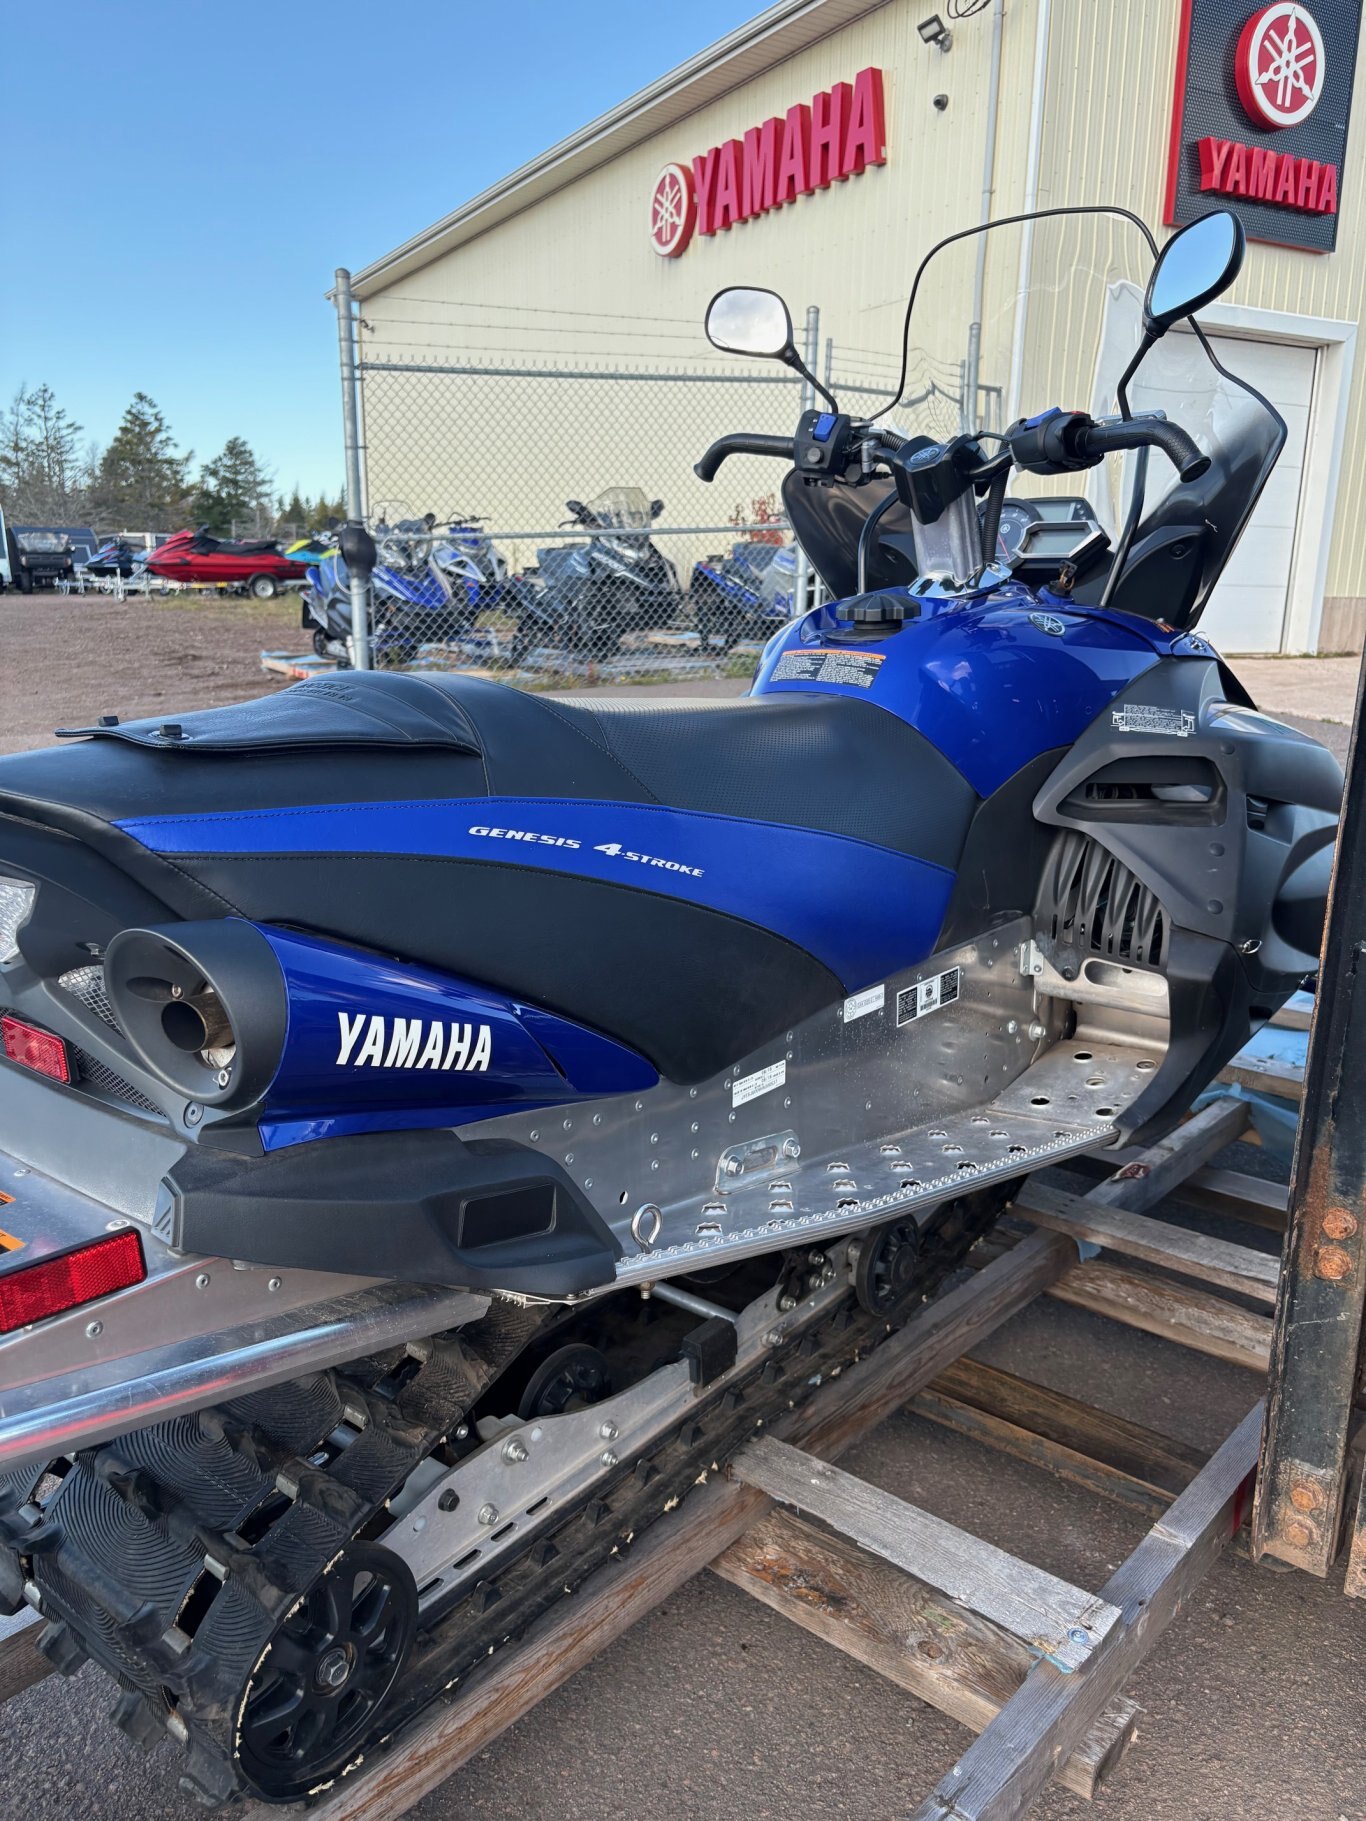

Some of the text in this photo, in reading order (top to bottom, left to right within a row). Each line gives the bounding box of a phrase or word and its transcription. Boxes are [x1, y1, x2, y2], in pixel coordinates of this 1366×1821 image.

[692, 67, 887, 236] YAMAHA
[1198, 136, 1338, 214] YAMAHA
[468, 826, 582, 849] GENESIS
[336, 1012, 492, 1072] YAMAHA
